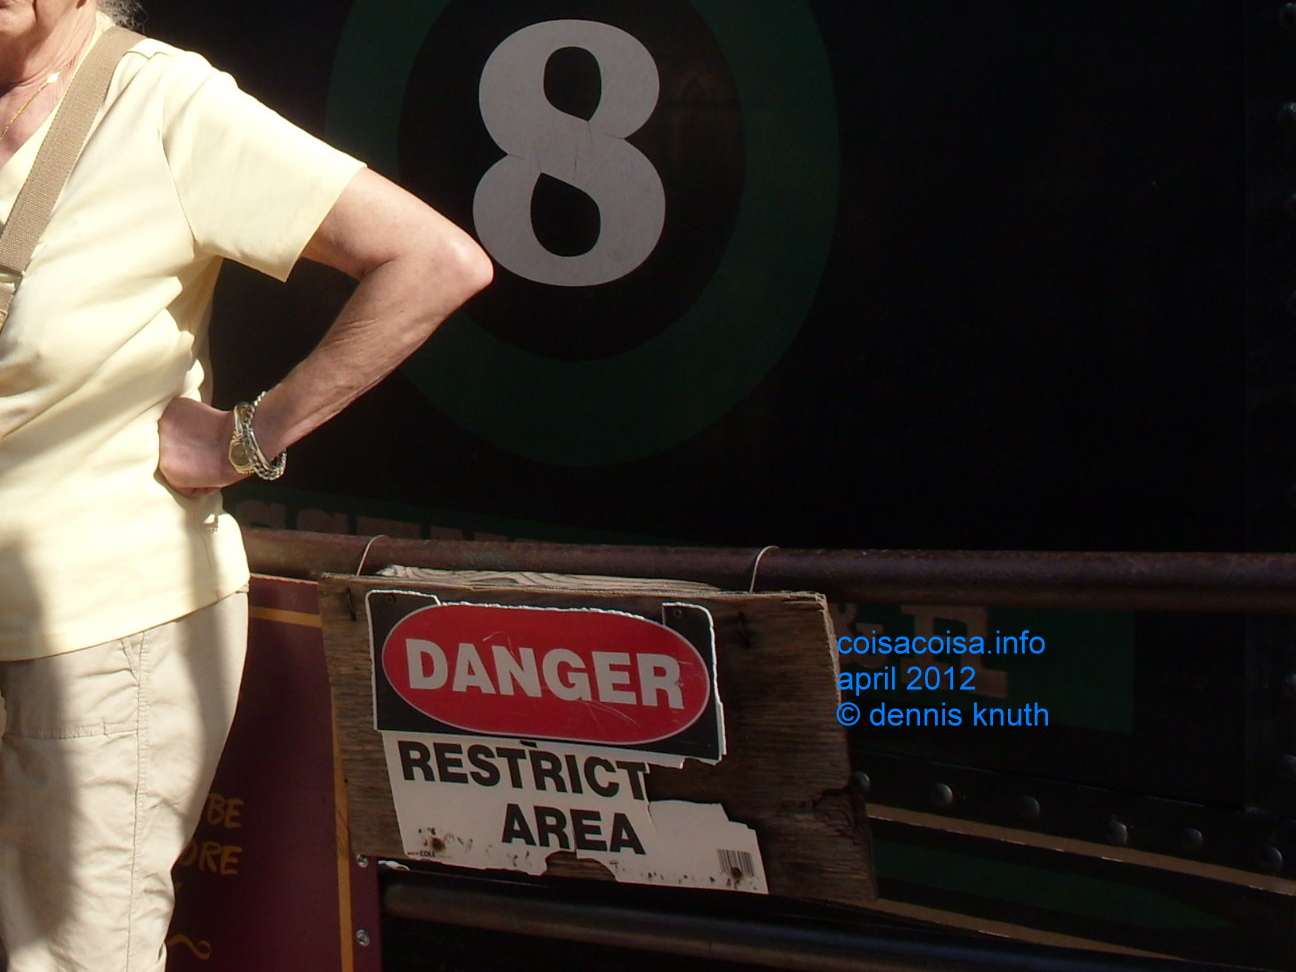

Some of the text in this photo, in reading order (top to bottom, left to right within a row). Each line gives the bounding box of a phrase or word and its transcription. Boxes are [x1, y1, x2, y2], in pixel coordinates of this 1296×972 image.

[472, 19, 666, 287] 8
[405, 637, 685, 710] DANGER
[397, 740, 648, 802] RESTRICT
[501, 803, 647, 856] AREA
